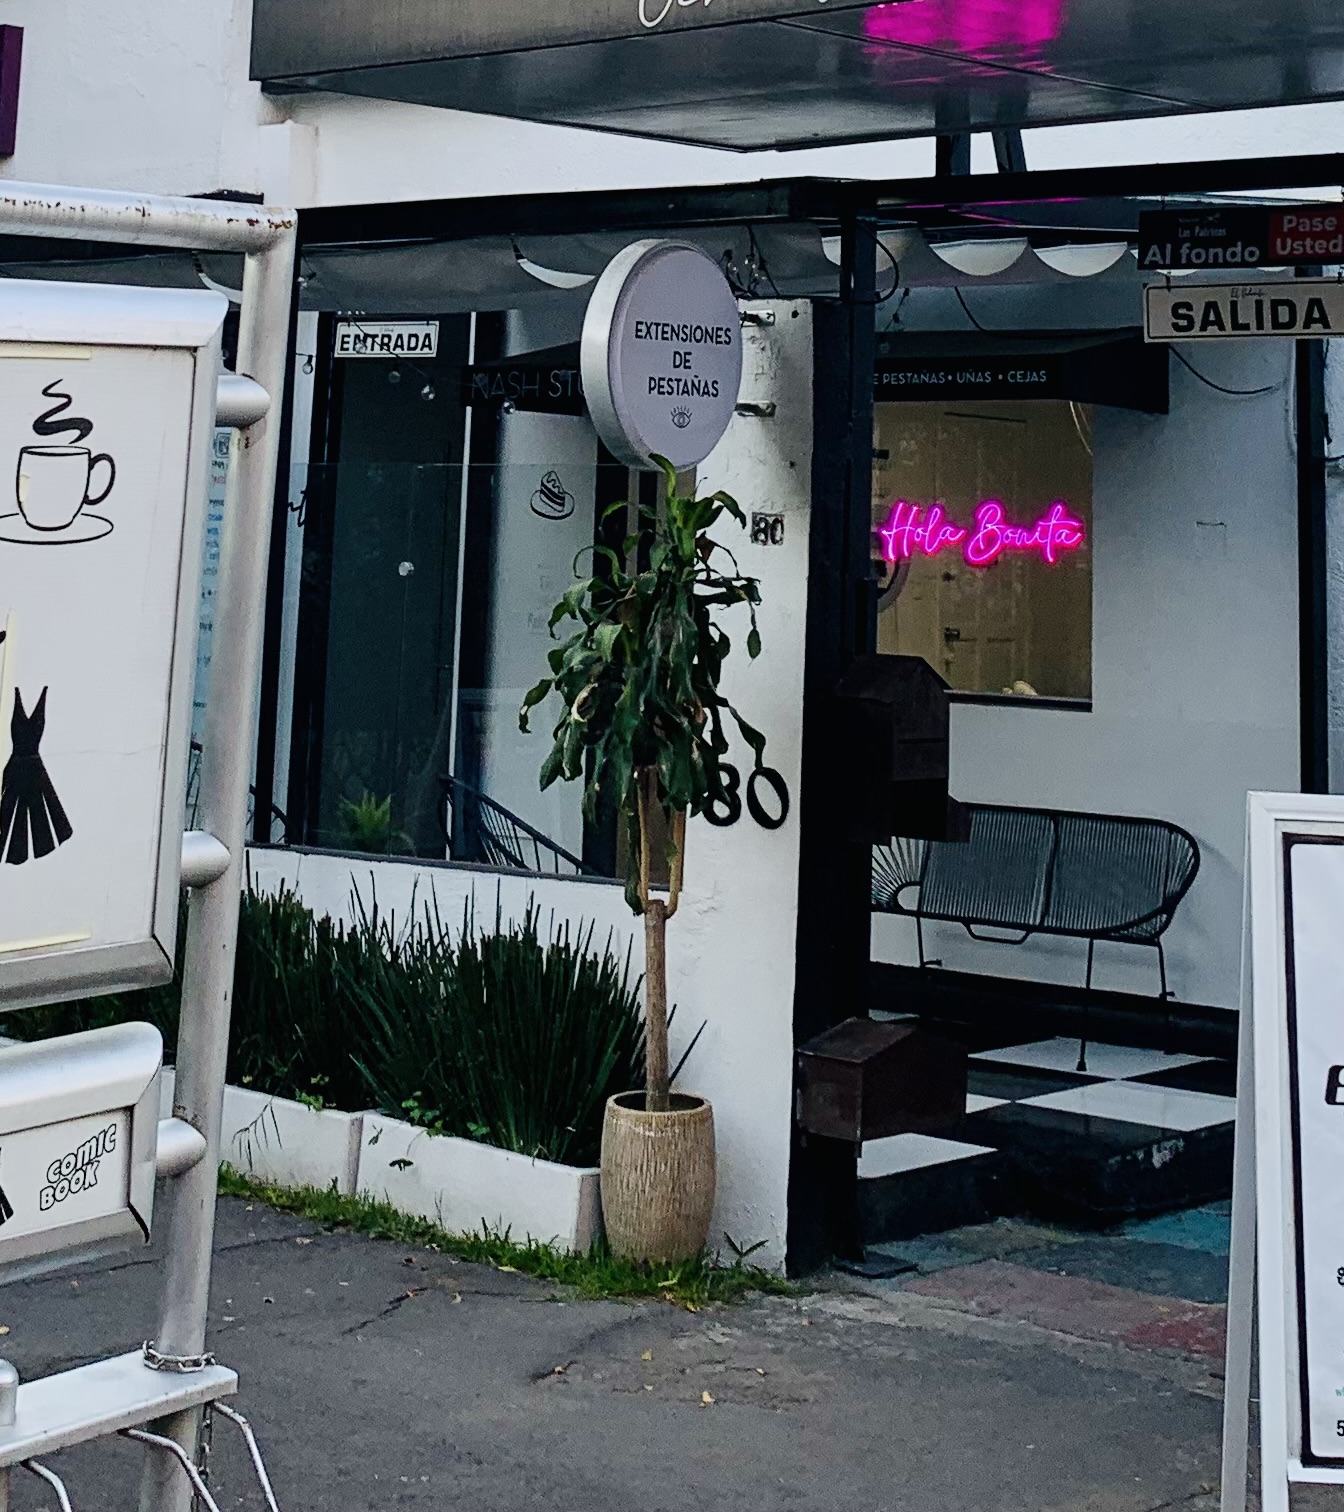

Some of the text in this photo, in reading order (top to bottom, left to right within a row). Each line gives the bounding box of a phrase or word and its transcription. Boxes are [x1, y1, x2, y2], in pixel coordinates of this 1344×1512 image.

[1282, 214, 1338, 233] Pase
[1143, 240, 1260, 265] Al fondo
[1275, 234, 1344, 256] Usted
[1170, 297, 1332, 333] SALIDA
[339, 332, 433, 352] ENTRADA
[634, 320, 732, 346] EXTENSIONES
[672, 350, 693, 370] DE
[648, 374, 720, 399] PESTAÑAS
[882, 370, 946, 385] PESTAÑAS
[956, 368, 992, 384] UÑAS
[1007, 370, 1047, 383] CEJAS
[755, 515, 785, 545] 80
[880, 500, 1086, 564] Hola Bonita
[702, 761, 791, 830] 80
[46, 1123, 117, 1184] COMIC
[39, 1159, 101, 1212] BOOK
